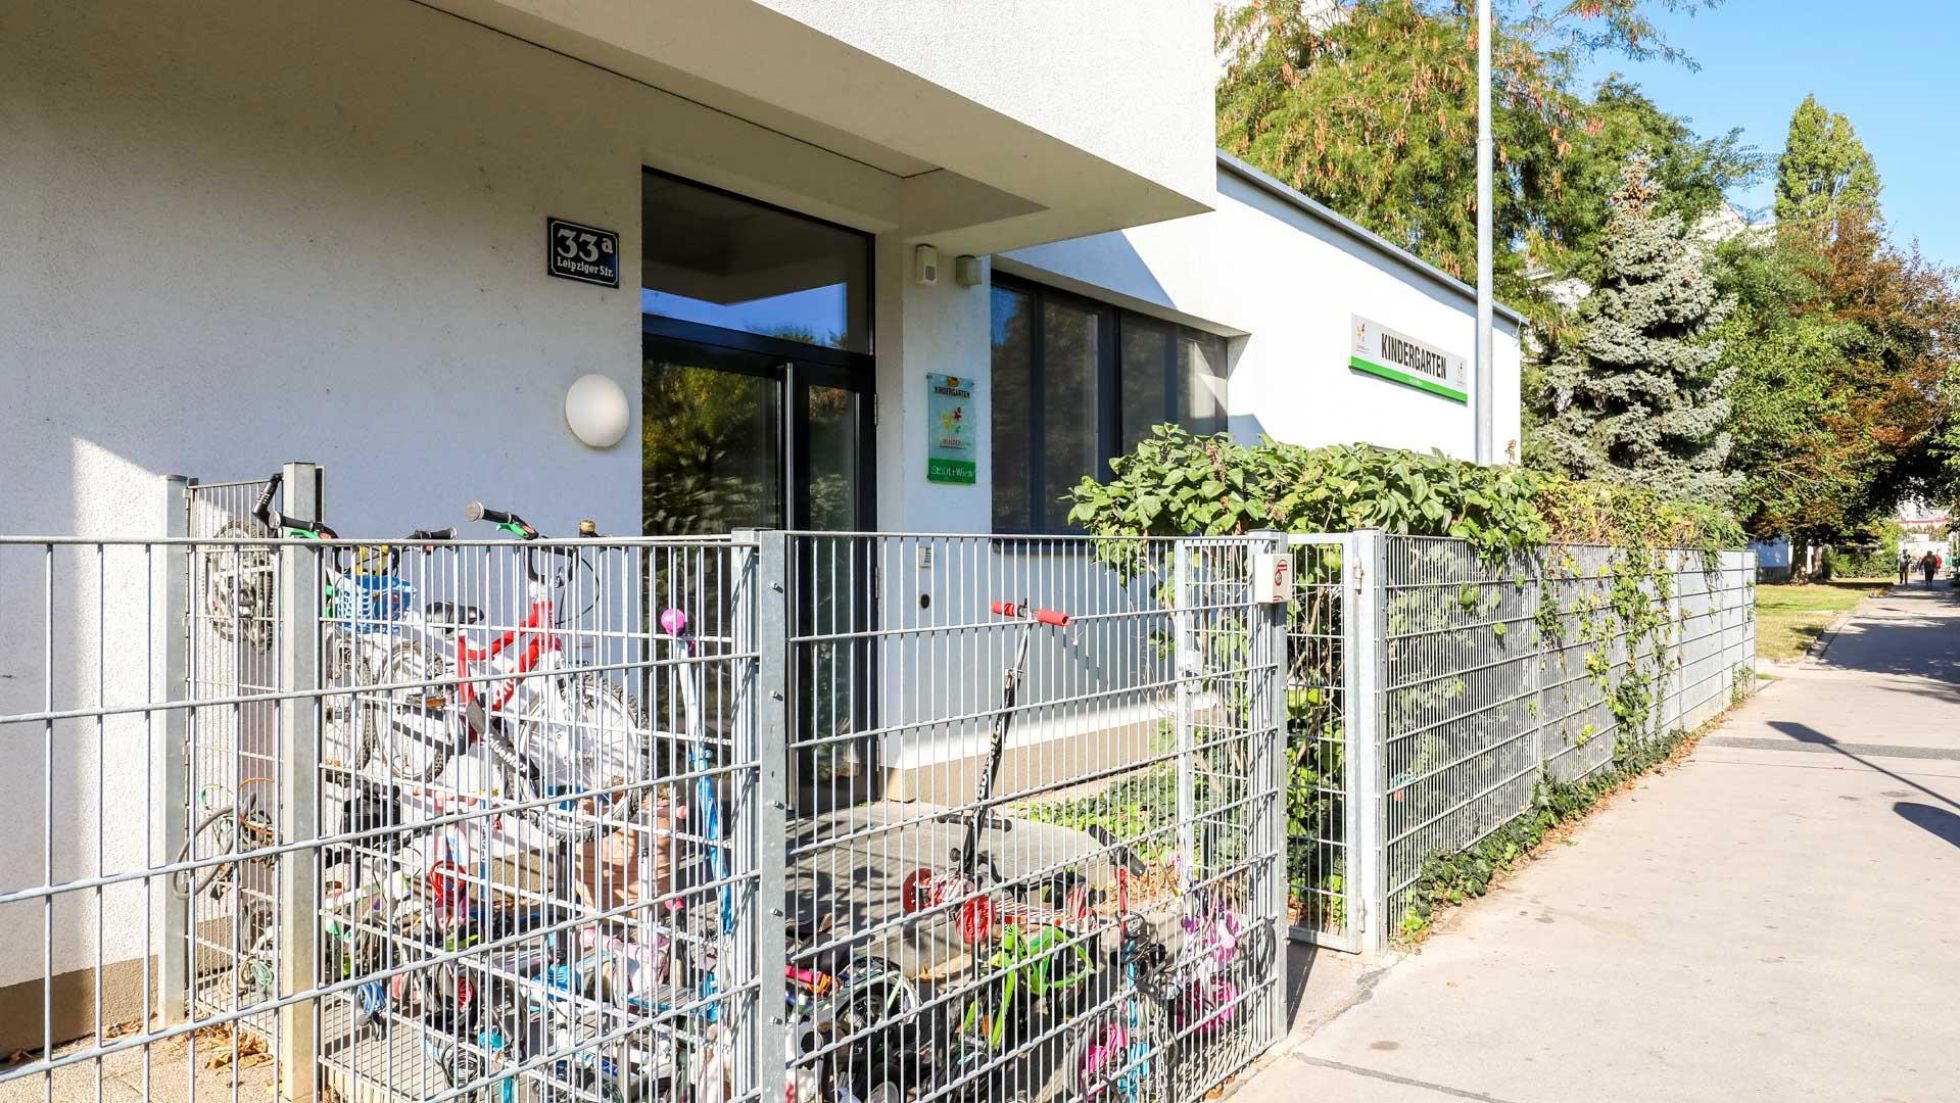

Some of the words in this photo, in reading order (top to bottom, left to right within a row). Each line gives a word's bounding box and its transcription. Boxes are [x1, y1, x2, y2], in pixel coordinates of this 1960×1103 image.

[557, 228, 614, 262] 33a
[557, 256, 598, 274] Leipziger
[599, 265, 614, 277] Str.
[1381, 332, 1447, 380] KINDERGARTEN
